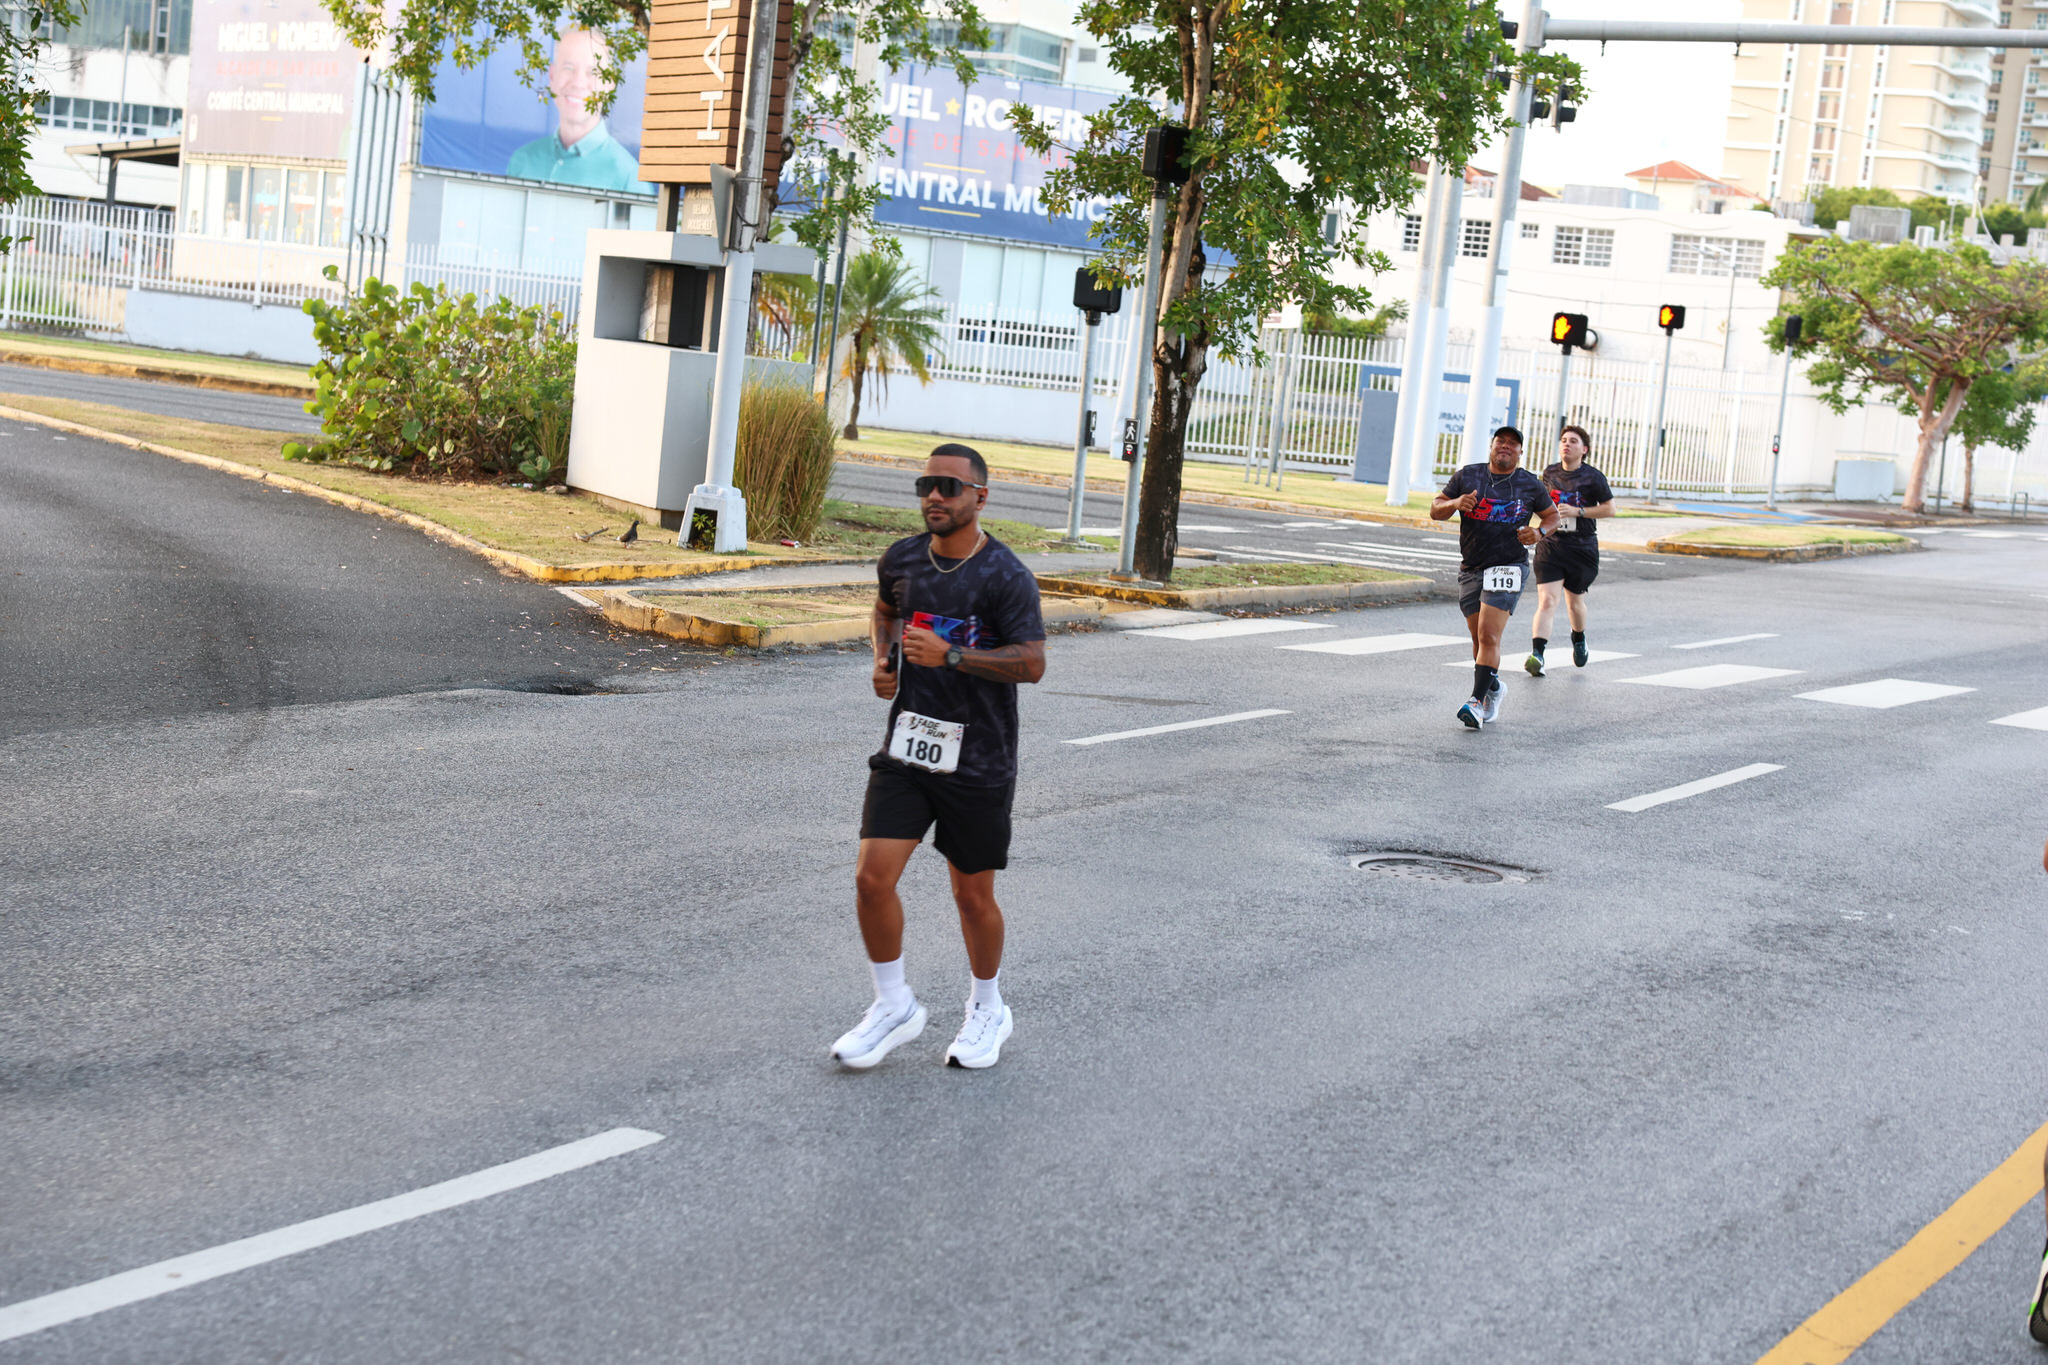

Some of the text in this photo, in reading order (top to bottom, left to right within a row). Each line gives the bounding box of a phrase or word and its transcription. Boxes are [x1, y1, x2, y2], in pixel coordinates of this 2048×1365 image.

[218, 21, 341, 52] MIGUEL ROMERO
[244, 90, 287, 112] CENTRAL
[288, 92, 344, 114] MUNICIPAL
[934, 132, 962, 153] DE
[978, 139, 1026, 163] SAN
[878, 165, 996, 209] ENTRAL
[1491, 577, 1514, 589] 119
[918, 718, 941, 730] FADE
[926, 728, 948, 739] RUN
[906, 737, 942, 764] 180
